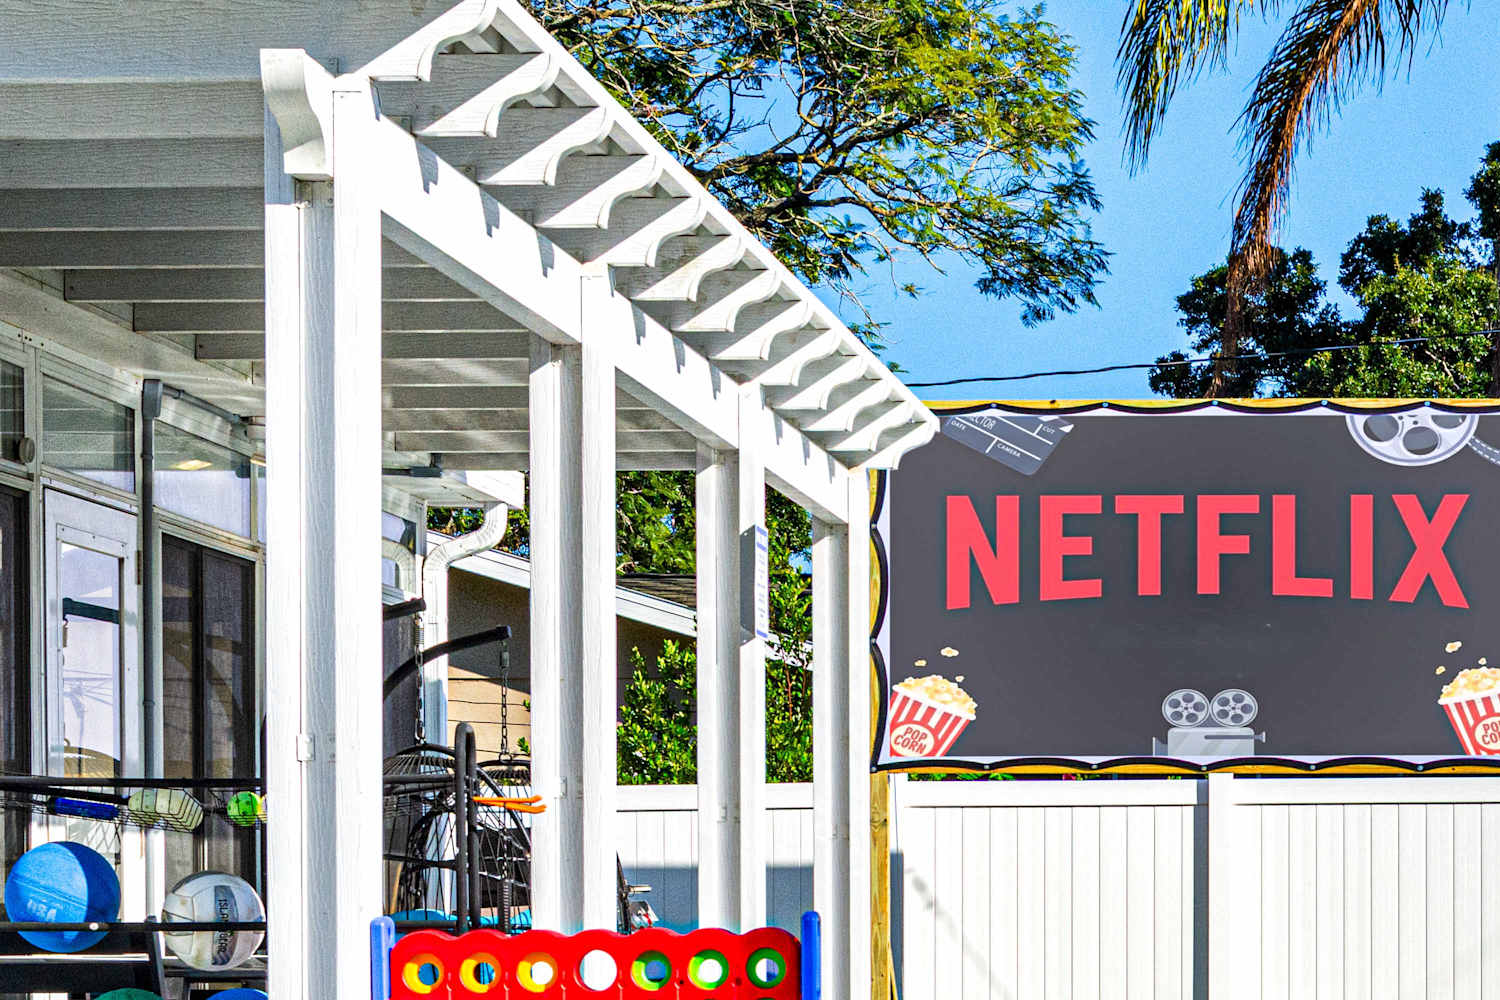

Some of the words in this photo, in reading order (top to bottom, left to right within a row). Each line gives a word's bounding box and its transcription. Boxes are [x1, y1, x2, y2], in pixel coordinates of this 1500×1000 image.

[1042, 425, 1056, 435] CUT
[996, 443, 1021, 458] CAMERA
[946, 494, 1470, 610] NETFLIX
[903, 726, 928, 742] POP
[893, 734, 927, 754] CORN
